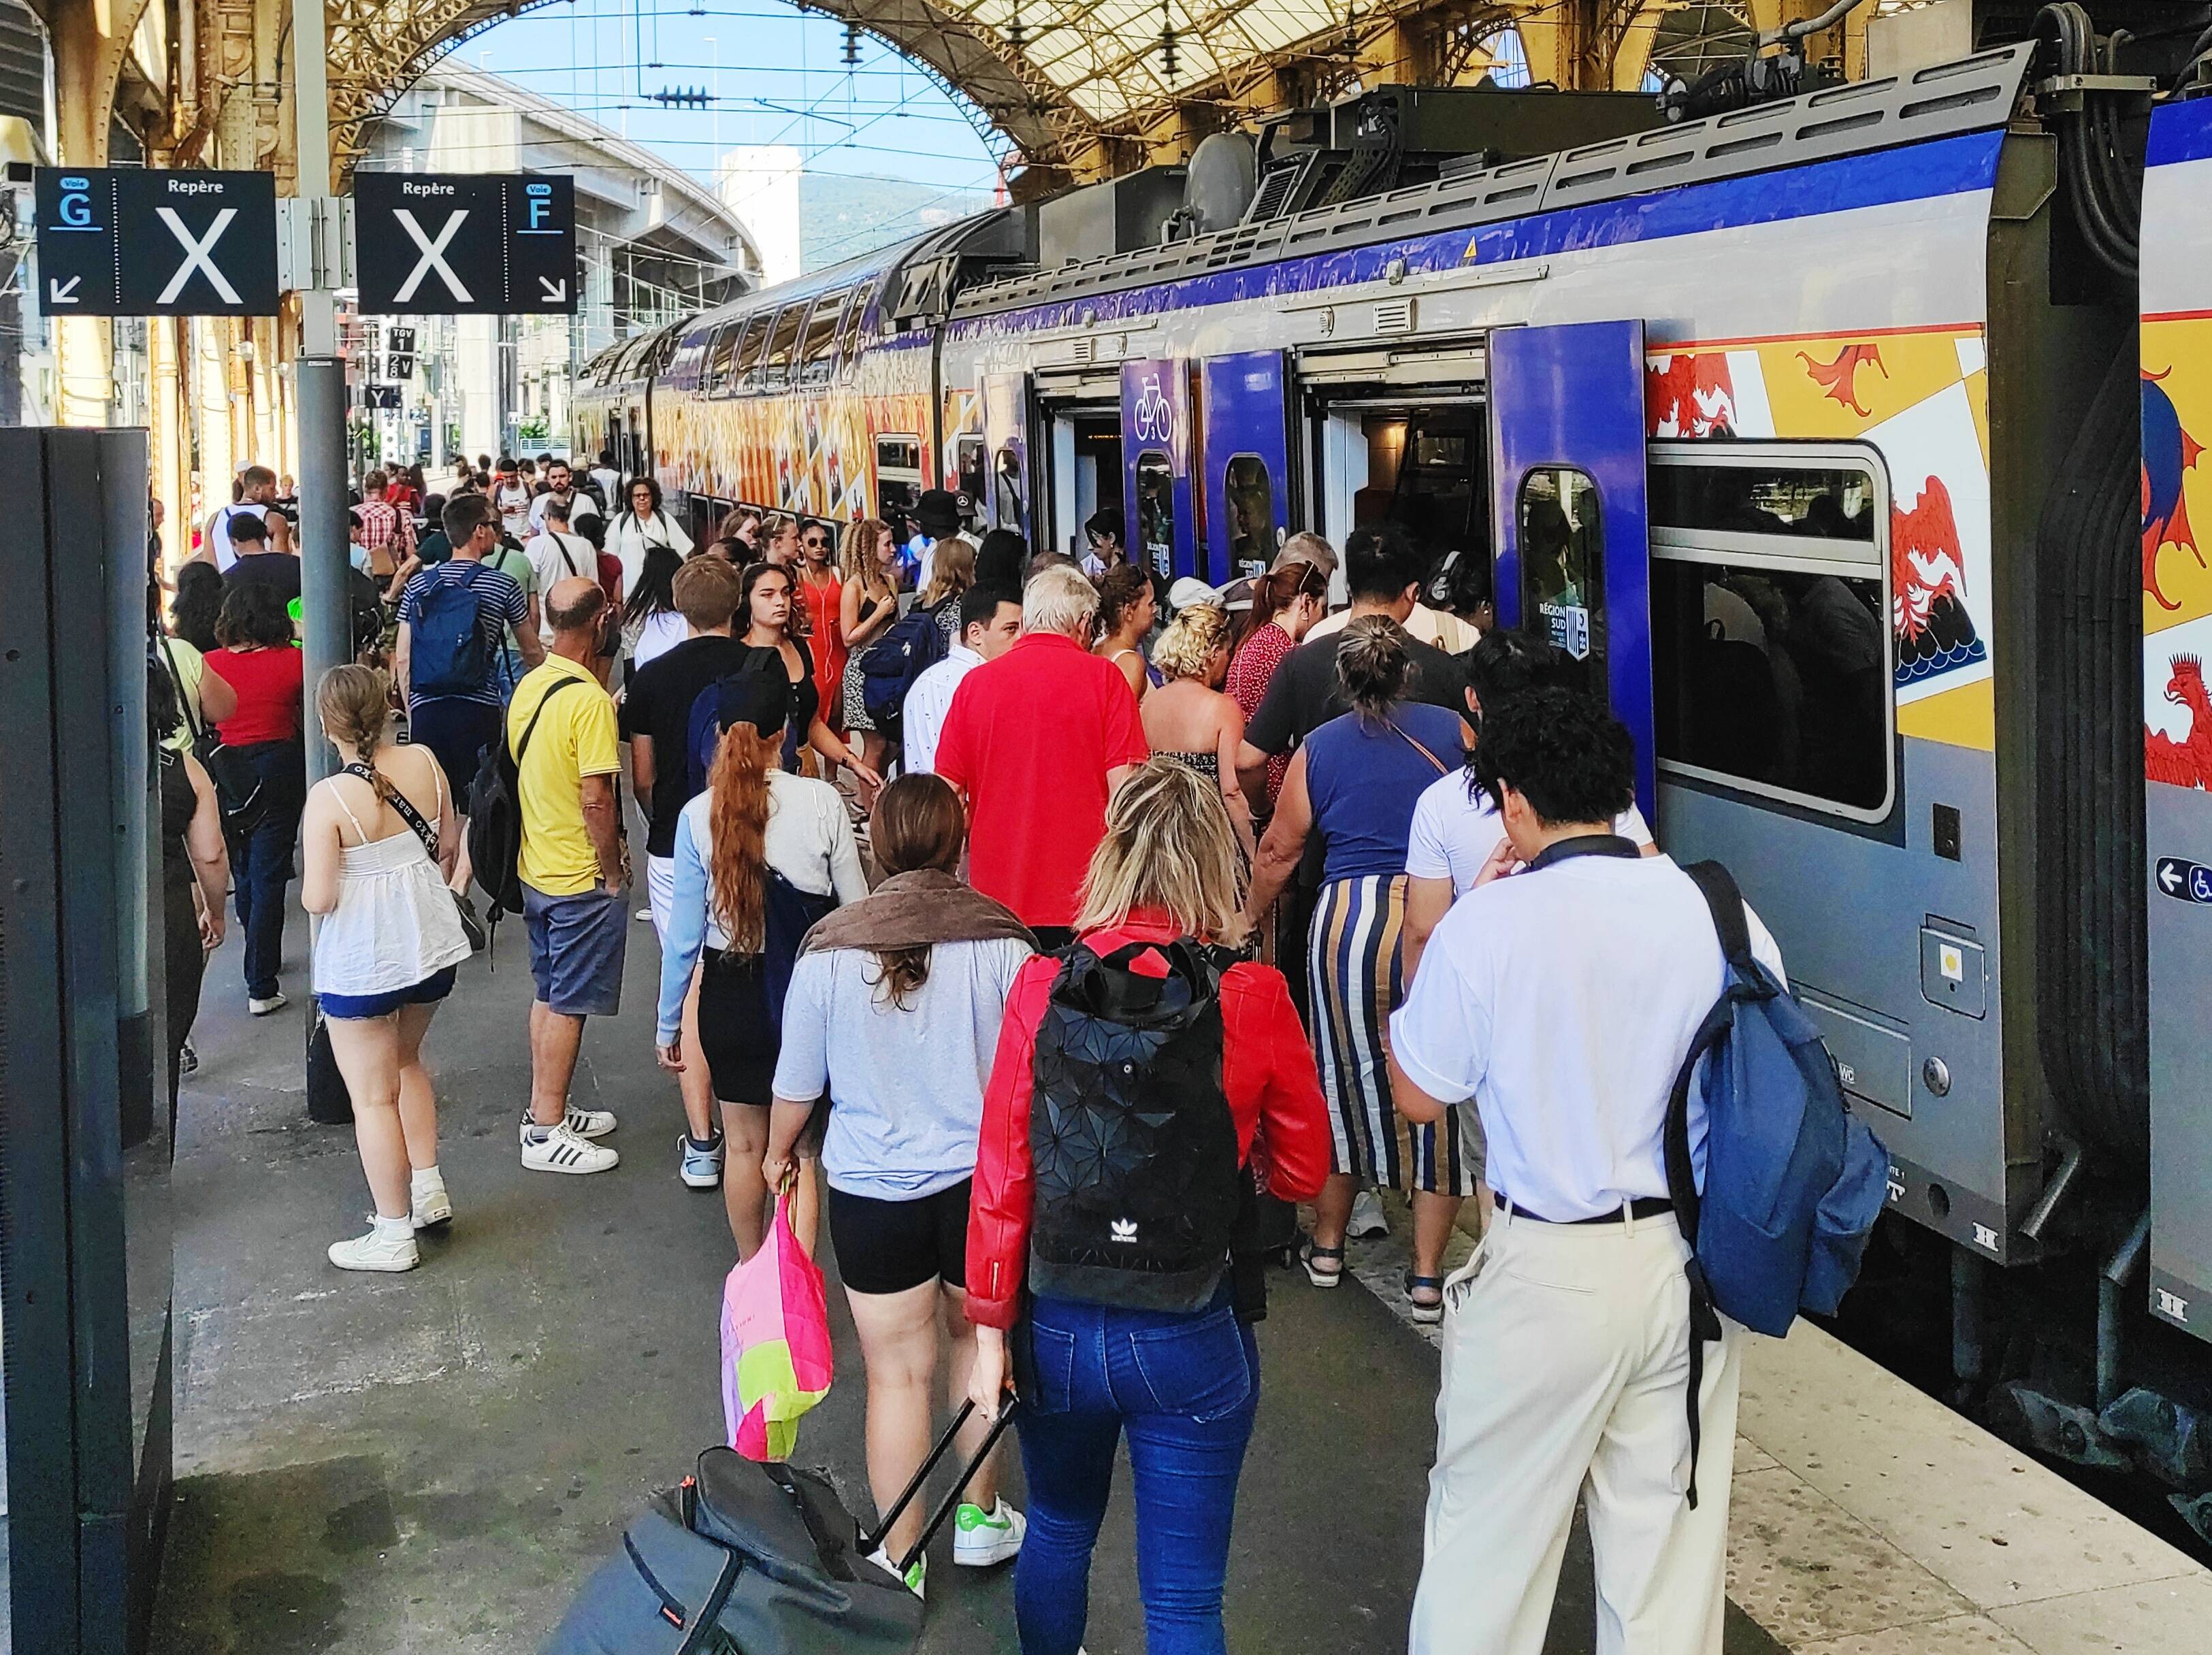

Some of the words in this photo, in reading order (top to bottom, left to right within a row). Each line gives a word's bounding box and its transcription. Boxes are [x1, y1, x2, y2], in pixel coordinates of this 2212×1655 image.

[168, 179, 224, 196] Repère
[403, 182, 455, 197] Repère
[530, 186, 548, 194] Voie
[59, 193, 91, 226] G
[530, 199, 551, 229] F
[155, 207, 244, 304] X
[392, 209, 475, 302] X
[393, 328, 413, 338] TGV
[371, 390, 385, 407] Y
[1540, 602, 1565, 618] RÉGION
[1551, 618, 1566, 629] SUD
[1840, 1064, 1854, 1082] WC
[1889, 1165, 1900, 1177] ITE
